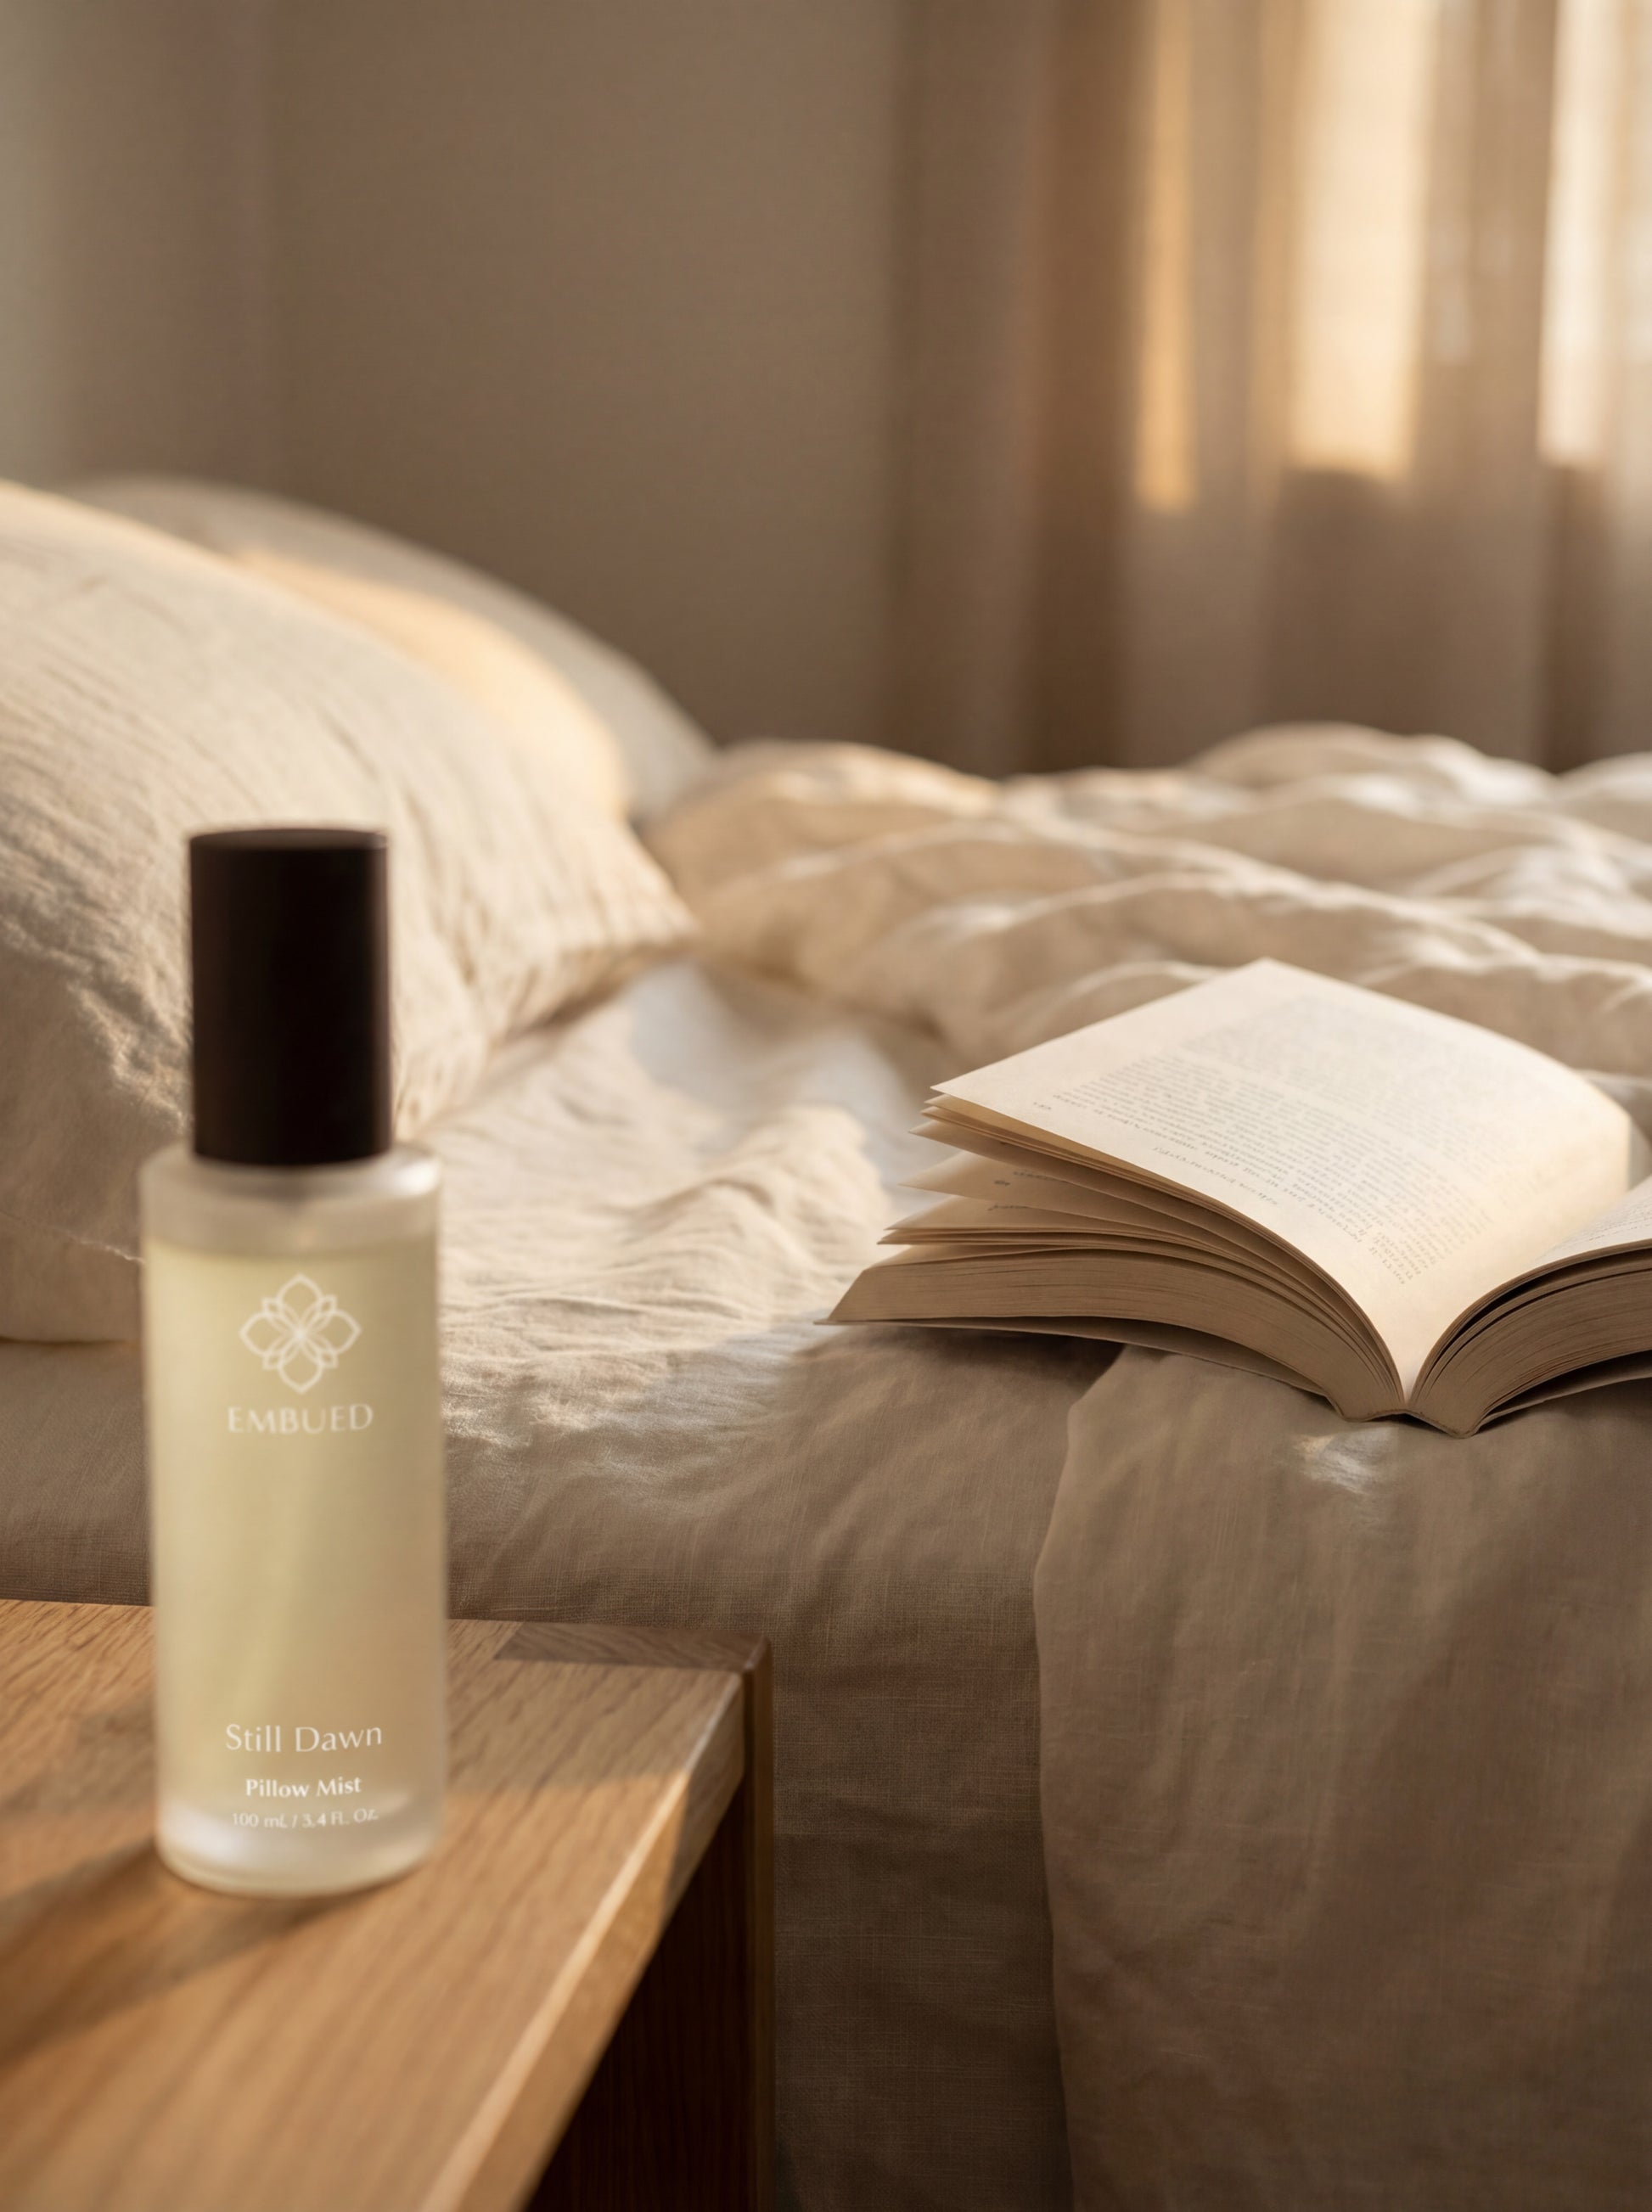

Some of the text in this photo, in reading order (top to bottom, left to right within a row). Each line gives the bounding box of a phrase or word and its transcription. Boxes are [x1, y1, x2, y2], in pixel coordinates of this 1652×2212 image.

[228, 1403, 374, 1434] EMBUED
[226, 1724, 382, 1752] Still Dawn
[245, 1777, 362, 1797] Pillow Mist
[233, 1812, 259, 1827] 100
[292, 1814, 298, 1828] /
[302, 1813, 326, 1828] 3.4
